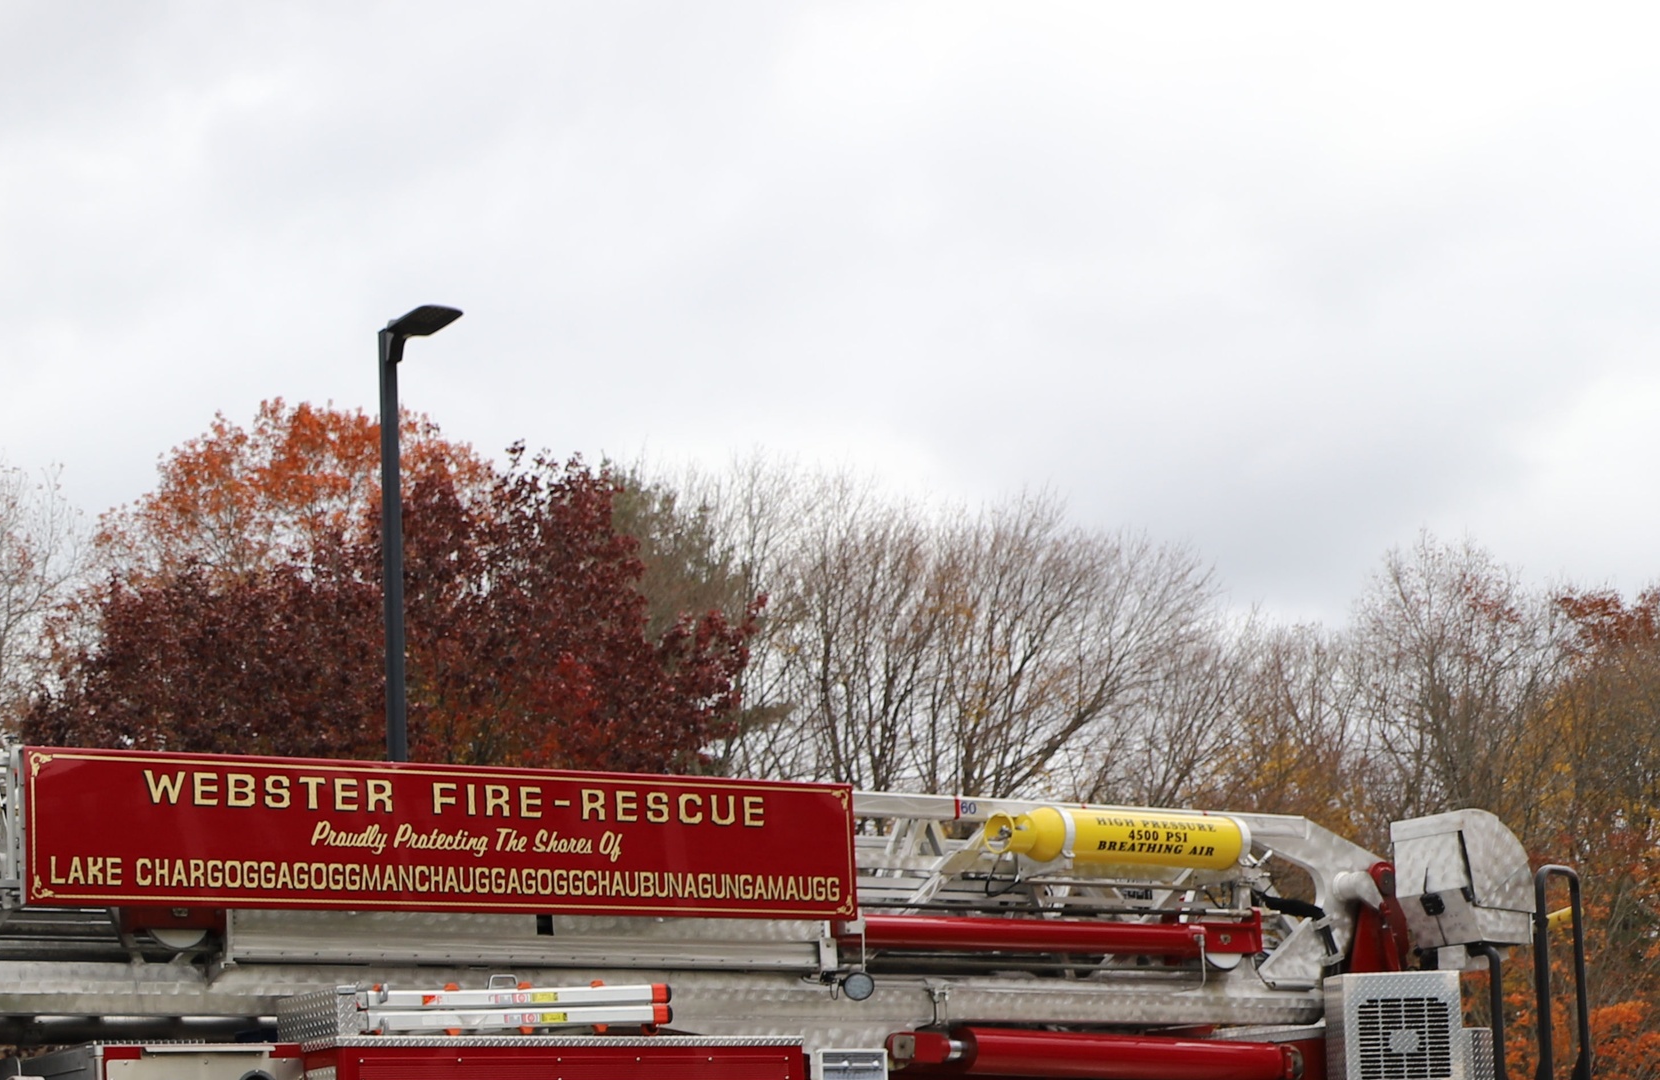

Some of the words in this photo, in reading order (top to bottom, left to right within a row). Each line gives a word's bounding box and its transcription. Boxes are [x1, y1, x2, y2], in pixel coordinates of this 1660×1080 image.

[143, 769, 394, 814] WEBSTER
[432, 782, 767, 828] FIRE-RESCUE
[961, 800, 977, 815] 60
[1096, 817, 1134, 829] HIGH
[1141, 820, 1217, 833] PRESSURE
[310, 820, 387, 855] Proudly
[393, 823, 489, 858] Protecting
[495, 827, 527, 853] The
[532, 829, 594, 855] Shores
[599, 831, 623, 863] Of
[1128, 830, 1159, 842] 4500
[1166, 833, 1188, 843] PSI
[1097, 840, 1183, 856] BREATHING
[1188, 845, 1215, 857] AIR
[49, 856, 123, 886] LAKE
